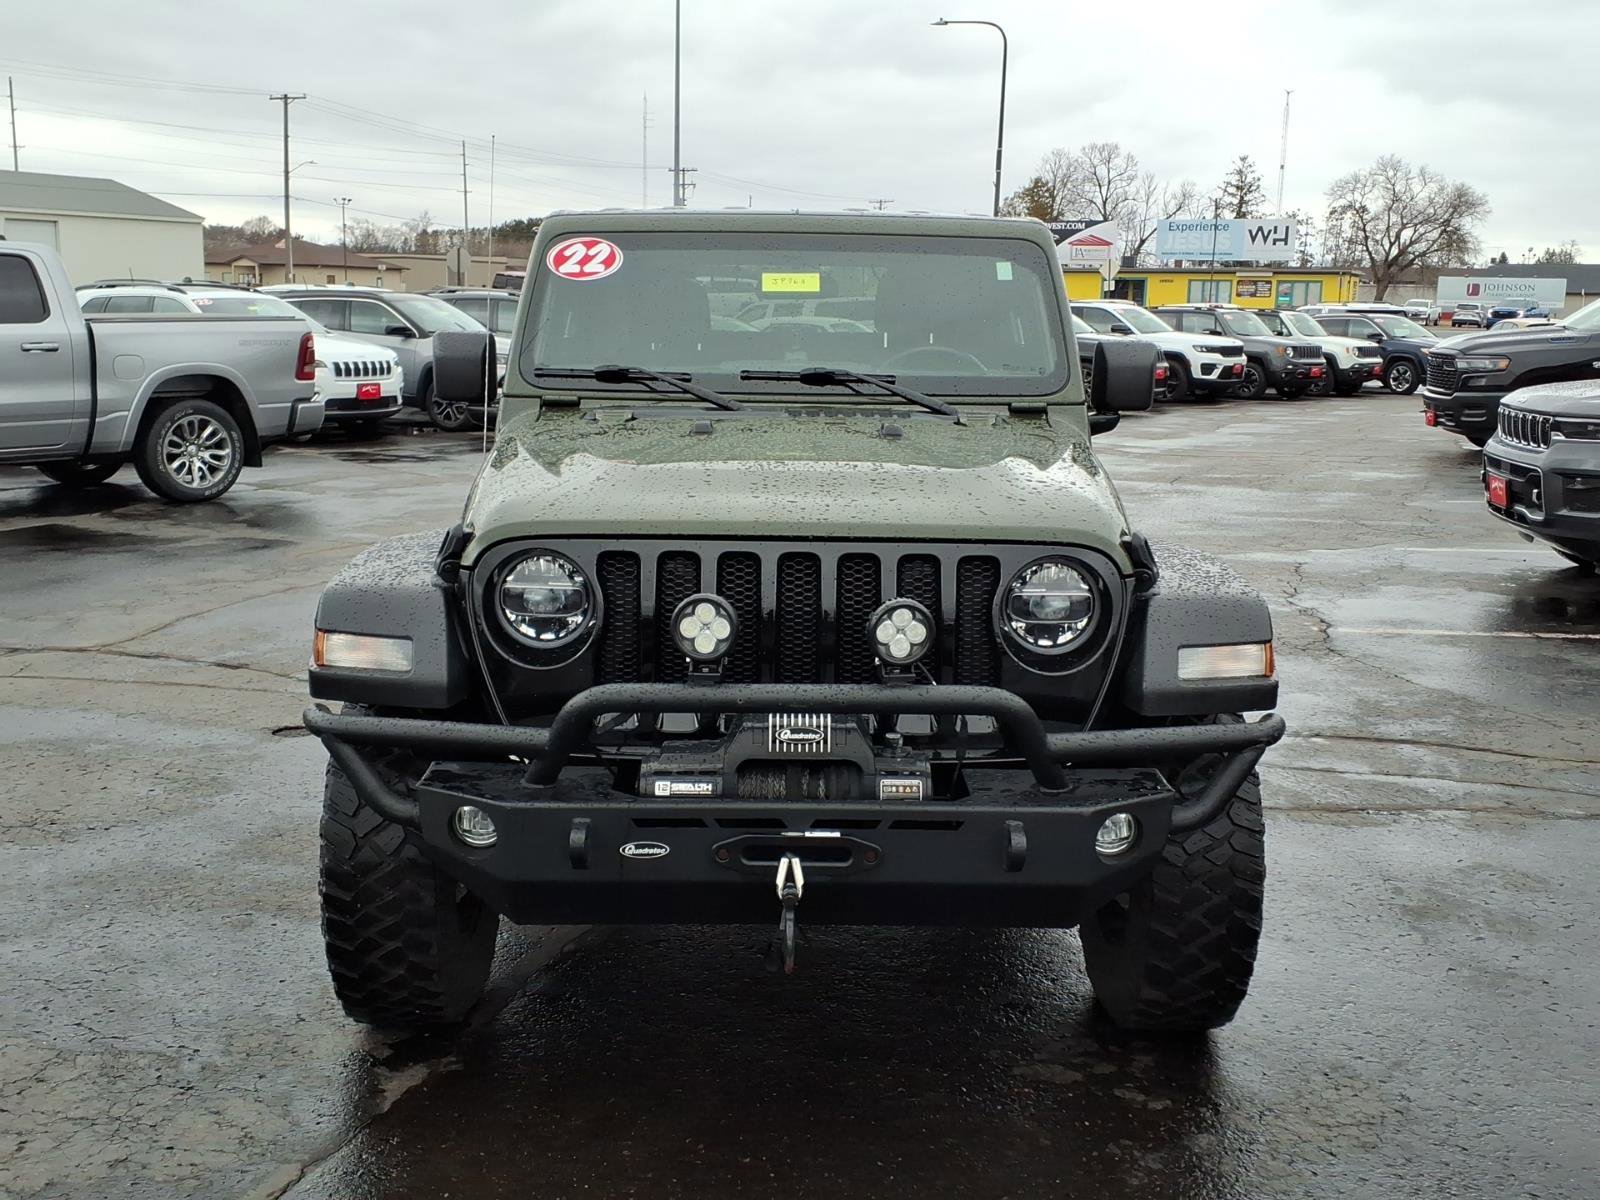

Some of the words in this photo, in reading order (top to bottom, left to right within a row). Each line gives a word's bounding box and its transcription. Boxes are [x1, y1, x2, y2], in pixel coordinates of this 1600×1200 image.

[1168, 221, 1230, 232] Experience
[1163, 232, 1232, 249] JESUS
[558, 242, 612, 273] 22
[1484, 283, 1536, 293] JOHNSON
[780, 729, 821, 739] Quadratec
[671, 783, 712, 791] STEALTH
[624, 844, 666, 855] Quadratec
